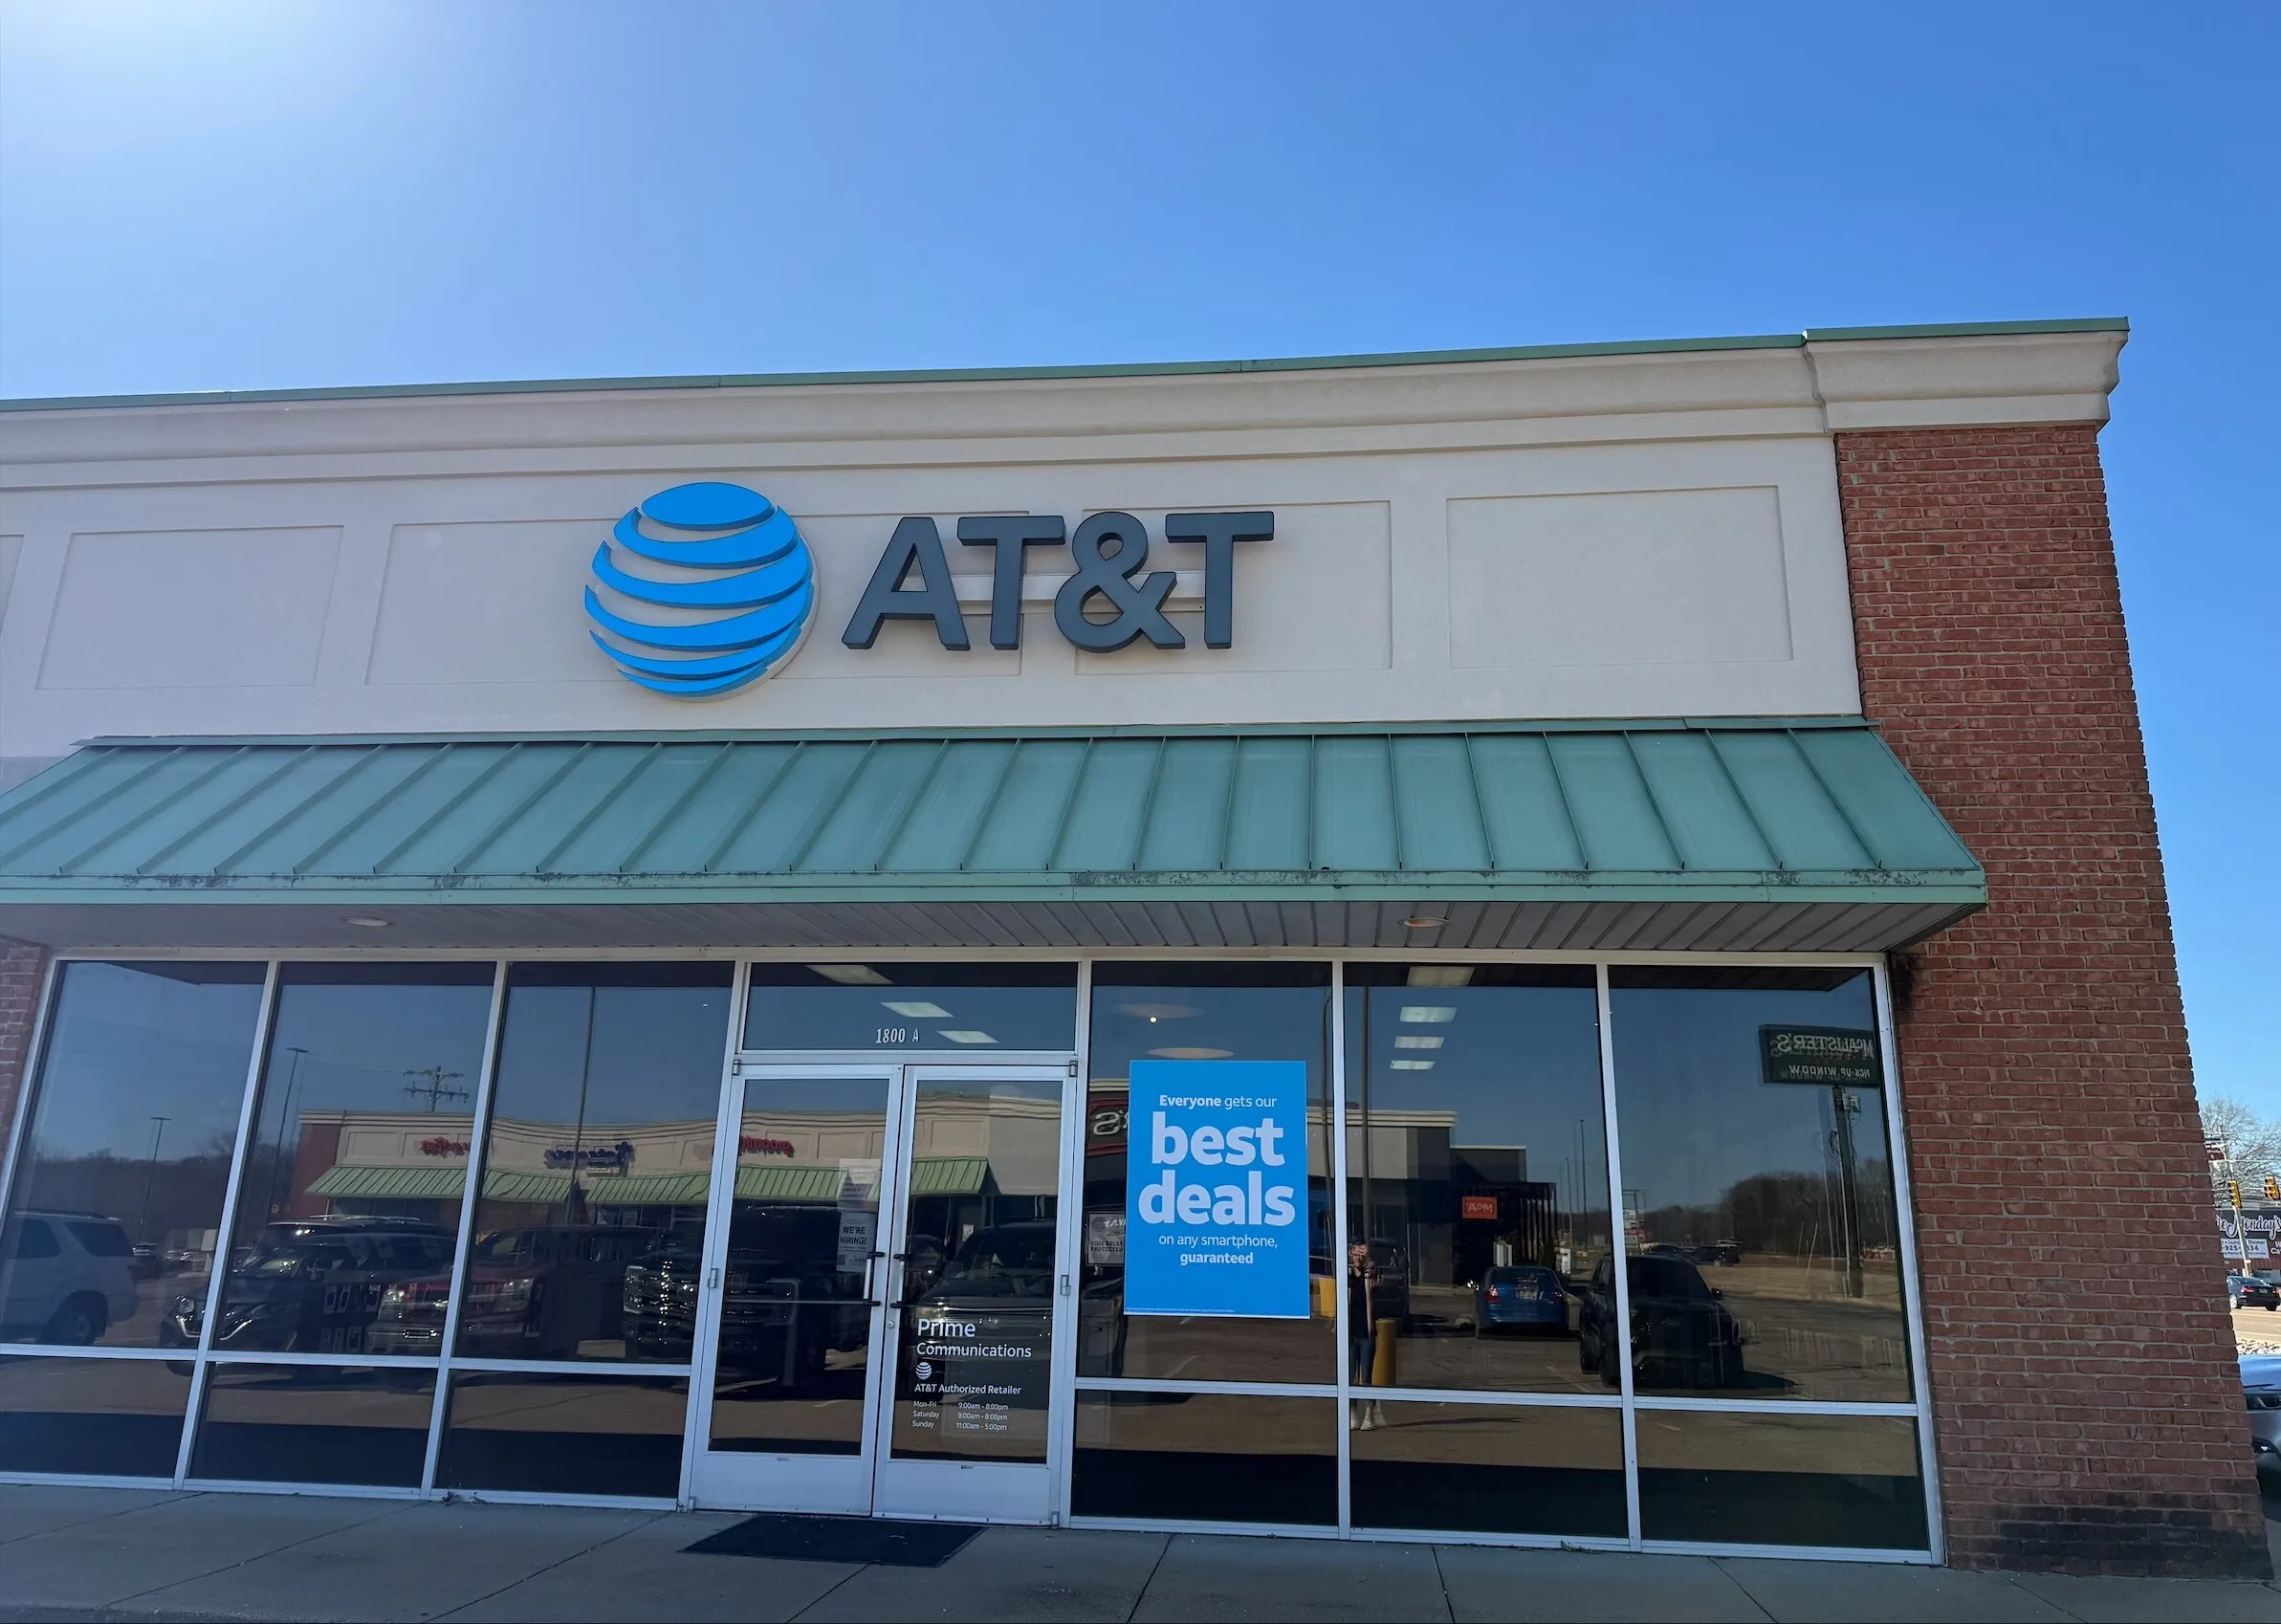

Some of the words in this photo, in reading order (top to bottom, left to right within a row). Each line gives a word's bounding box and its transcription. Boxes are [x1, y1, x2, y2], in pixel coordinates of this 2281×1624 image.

[842, 511, 1275, 653] AT&T
[875, 1027, 906, 1043] 1800
[911, 1027, 919, 1042] A
[1159, 1094, 1222, 1110] Everyone
[1224, 1096, 1253, 1110] gets
[1255, 1096, 1277, 1108] our
[1151, 1111, 1286, 1167] best
[1138, 1170, 1296, 1226] deals
[843, 1226, 866, 1235] WE'RE
[1158, 1235, 1174, 1244] on
[1176, 1235, 1199, 1246] any
[1200, 1234, 1278, 1249] smartphone,
[1179, 1251, 1254, 1266] guaranteed
[917, 1318, 976, 1337] Prime
[916, 1343, 1032, 1358] Communications
[914, 1384, 937, 1393] AT&T
[938, 1384, 986, 1394] Authorized
[988, 1385, 1021, 1394] Retailer
[912, 1410, 940, 1419] Saturday
[912, 1419, 935, 1429] Sunday
